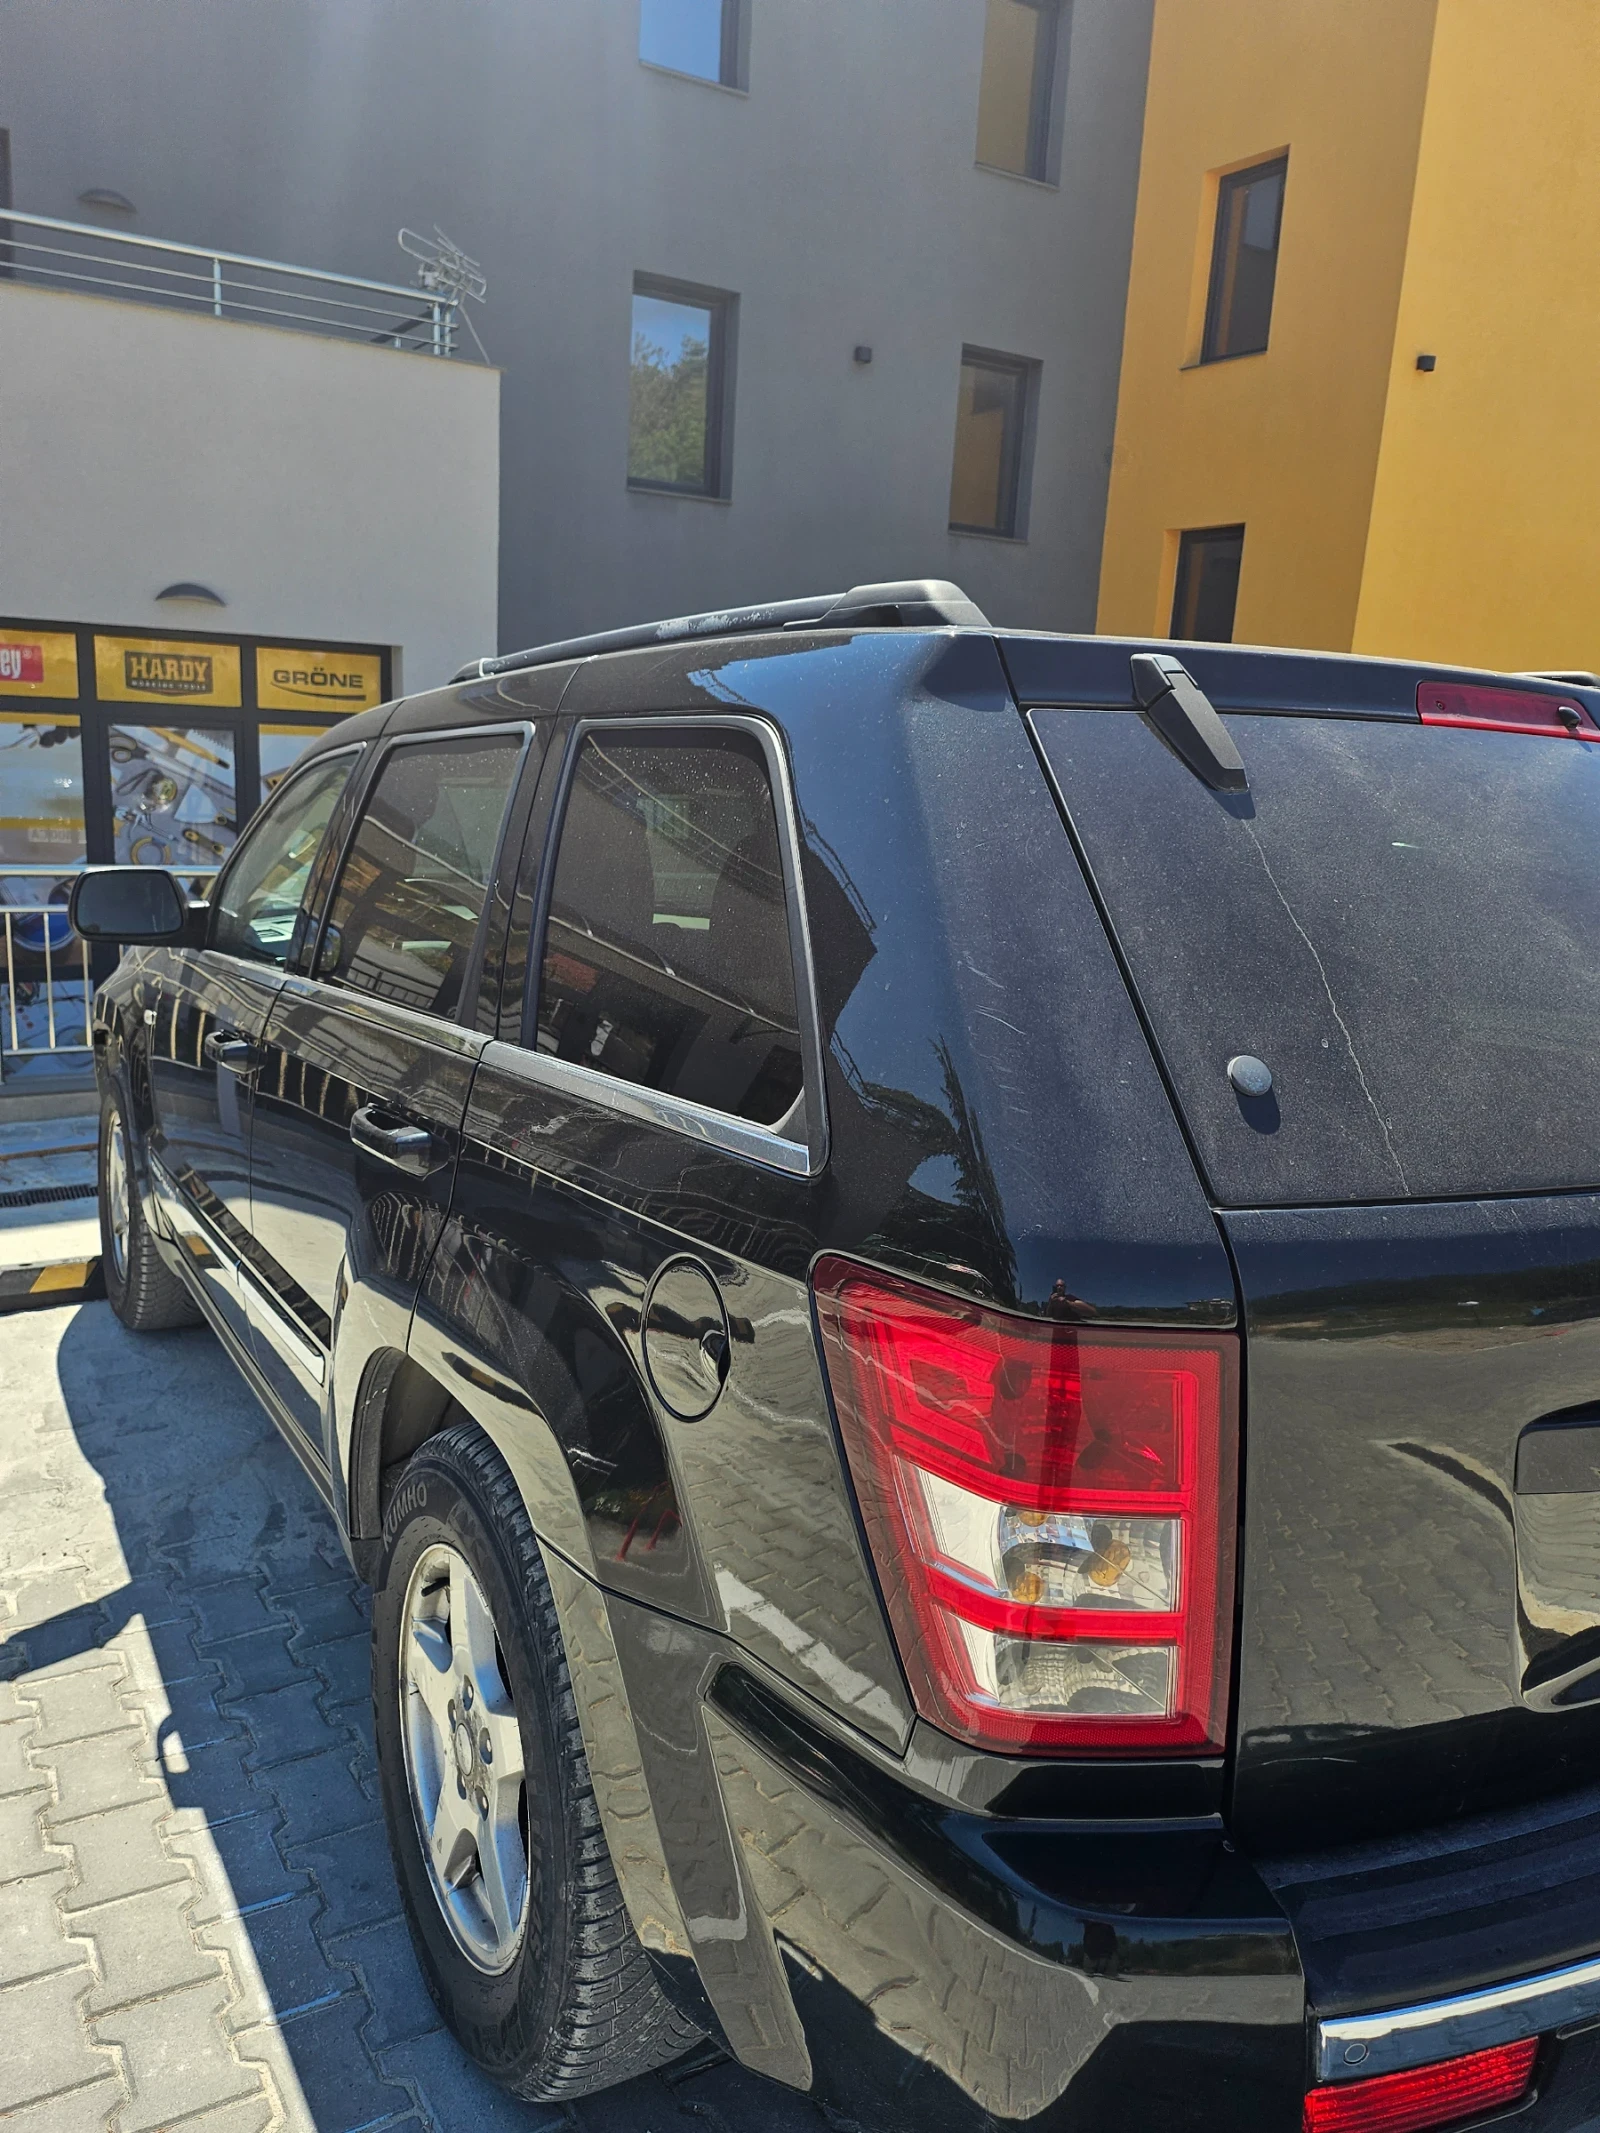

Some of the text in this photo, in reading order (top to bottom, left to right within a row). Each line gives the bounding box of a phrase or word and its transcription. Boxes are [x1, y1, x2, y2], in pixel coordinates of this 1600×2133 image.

[130, 656, 208, 682] HARDY
[273, 666, 364, 689] GRÖNE
[382, 1481, 428, 1553] KUMHO
